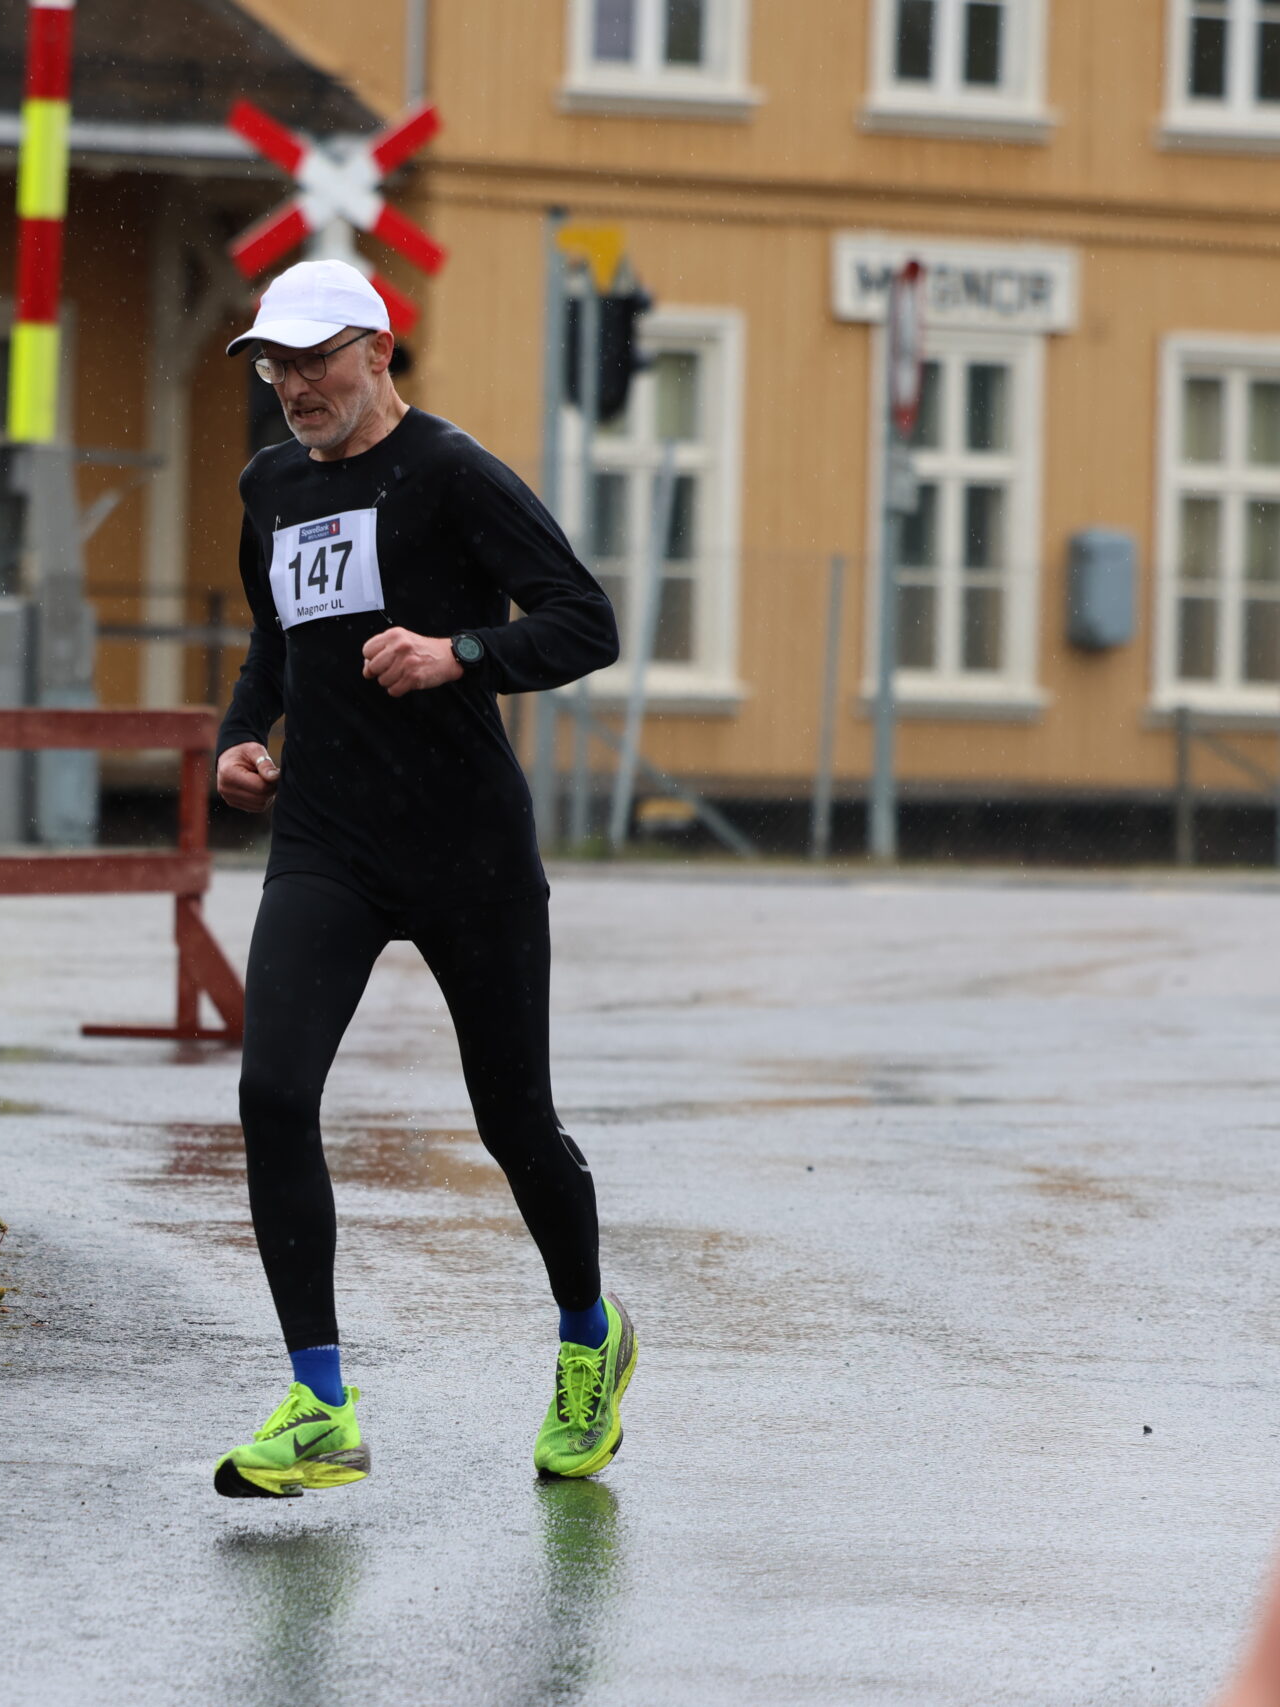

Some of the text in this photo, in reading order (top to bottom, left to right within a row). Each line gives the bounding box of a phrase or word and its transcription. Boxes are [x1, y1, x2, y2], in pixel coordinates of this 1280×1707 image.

[853, 260, 1052, 313] MGNOR
[288, 540, 353, 601] 147
[297, 598, 345, 617] Magnor UL
